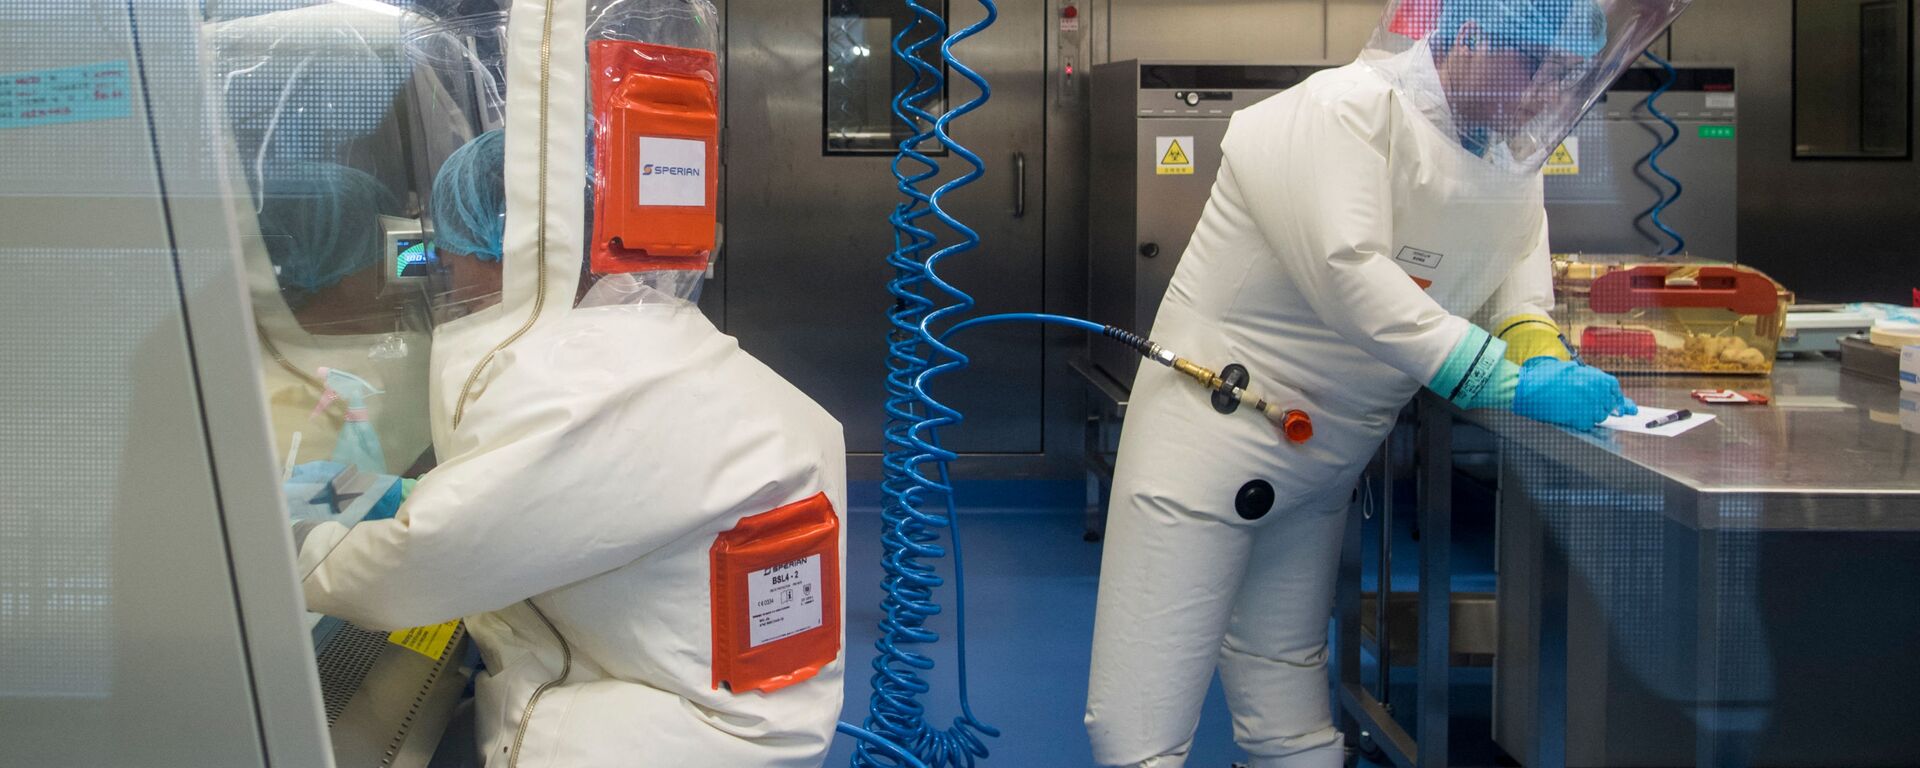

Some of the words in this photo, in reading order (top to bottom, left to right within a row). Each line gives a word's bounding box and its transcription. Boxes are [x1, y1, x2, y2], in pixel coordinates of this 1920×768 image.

[654, 166, 700, 177] SPERIAN
[772, 573, 789, 585] BSL4
[794, 570, 799, 578] 2
